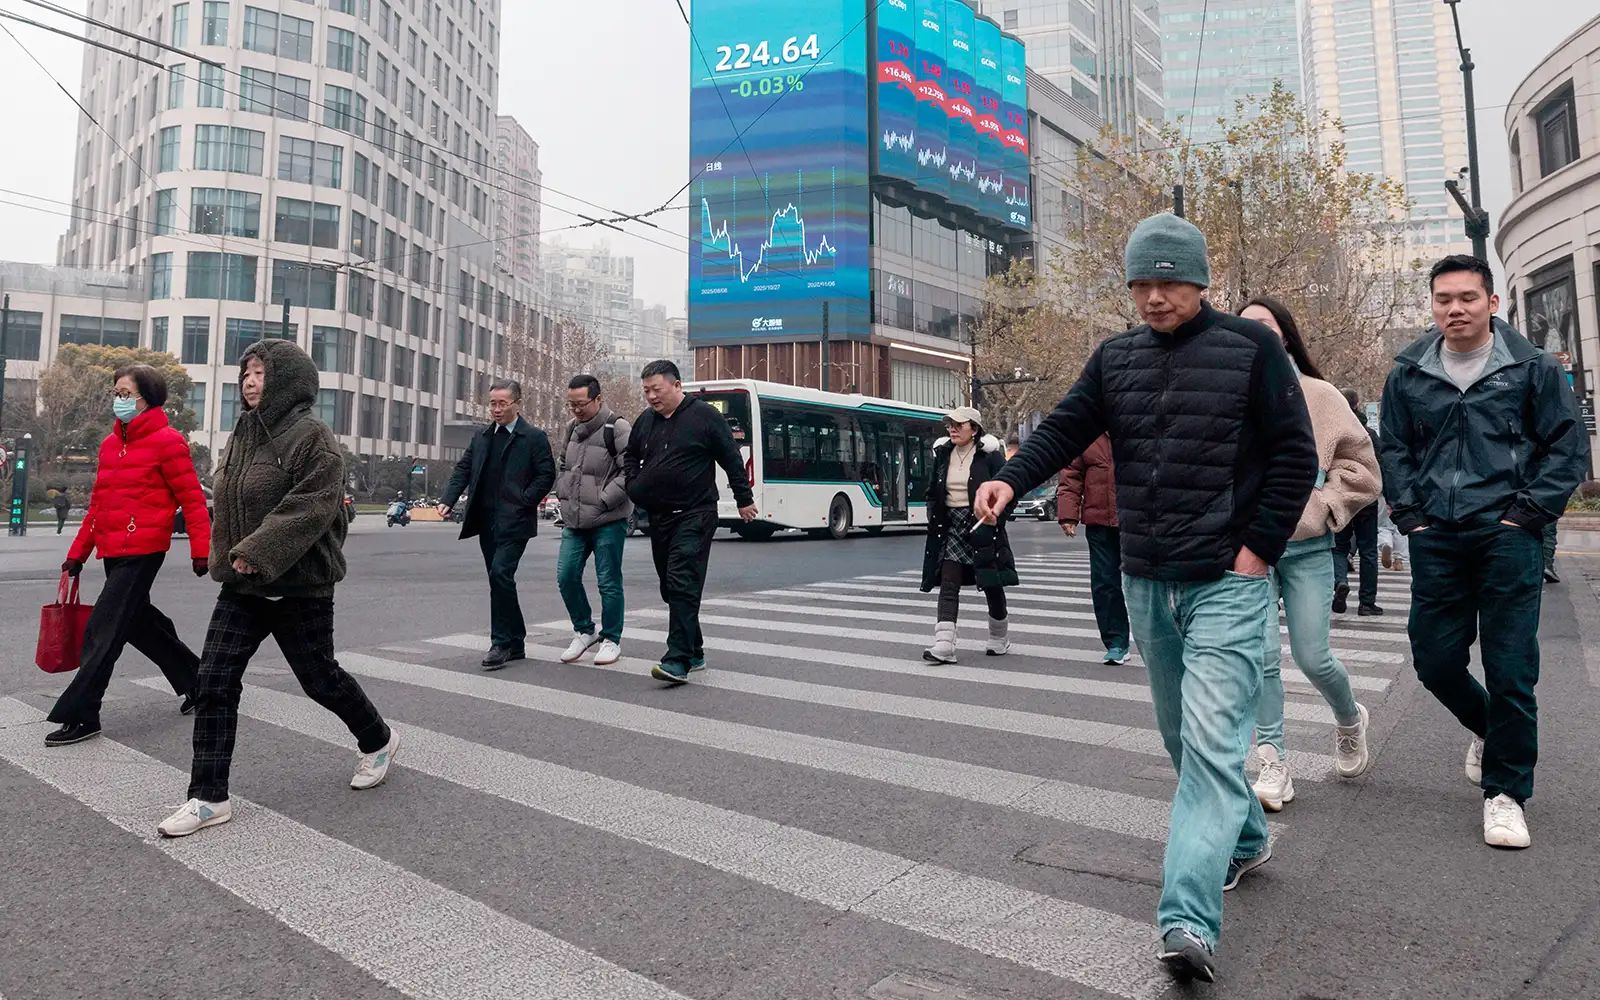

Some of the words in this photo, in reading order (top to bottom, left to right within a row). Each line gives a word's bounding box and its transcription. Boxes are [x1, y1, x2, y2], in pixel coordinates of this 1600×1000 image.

[715, 33, 820, 72] 224.64
[730, 74, 804, 97] -0.03%
[706, 161, 722, 172] 日线
